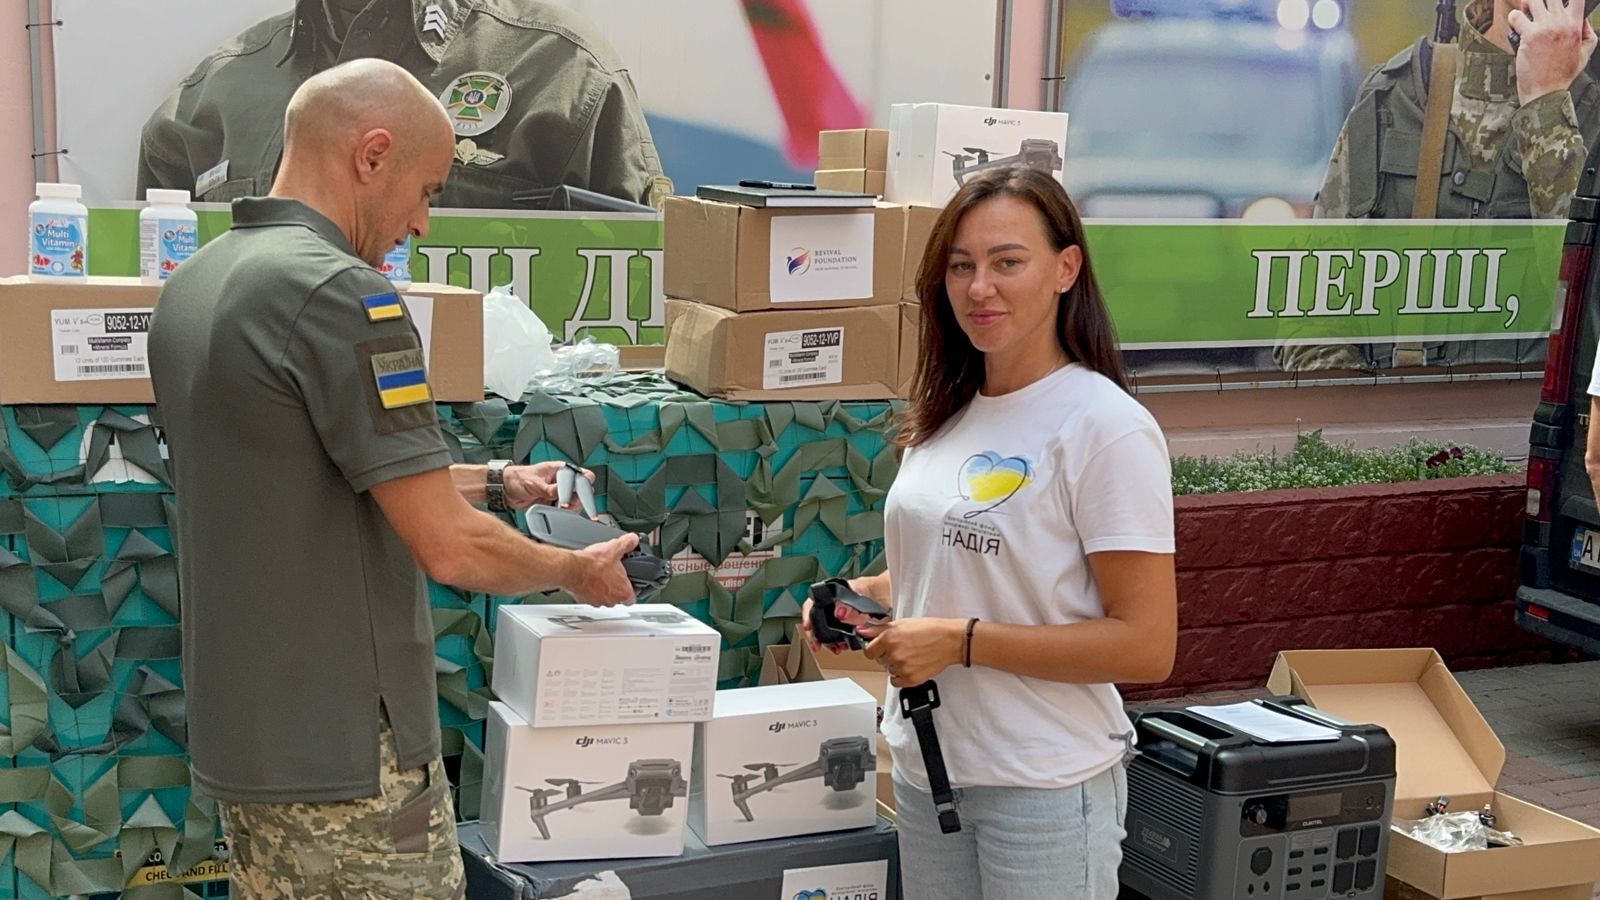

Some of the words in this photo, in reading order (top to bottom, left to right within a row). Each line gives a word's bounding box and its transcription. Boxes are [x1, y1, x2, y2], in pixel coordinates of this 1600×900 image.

[47, 230, 70, 238] Multi
[42, 238, 75, 248] Vitamin
[814, 249, 841, 257] REVIVAL
[814, 255, 858, 265] FOUNDATION
[1246, 247, 1521, 329] ПЕРШІ,
[941, 527, 1001, 556] НАДІЯ
[787, 719, 811, 729] MAVIC
[812, 719, 818, 727] 3
[596, 737, 622, 745] MAVIC
[208, 864, 228, 874] FILL
